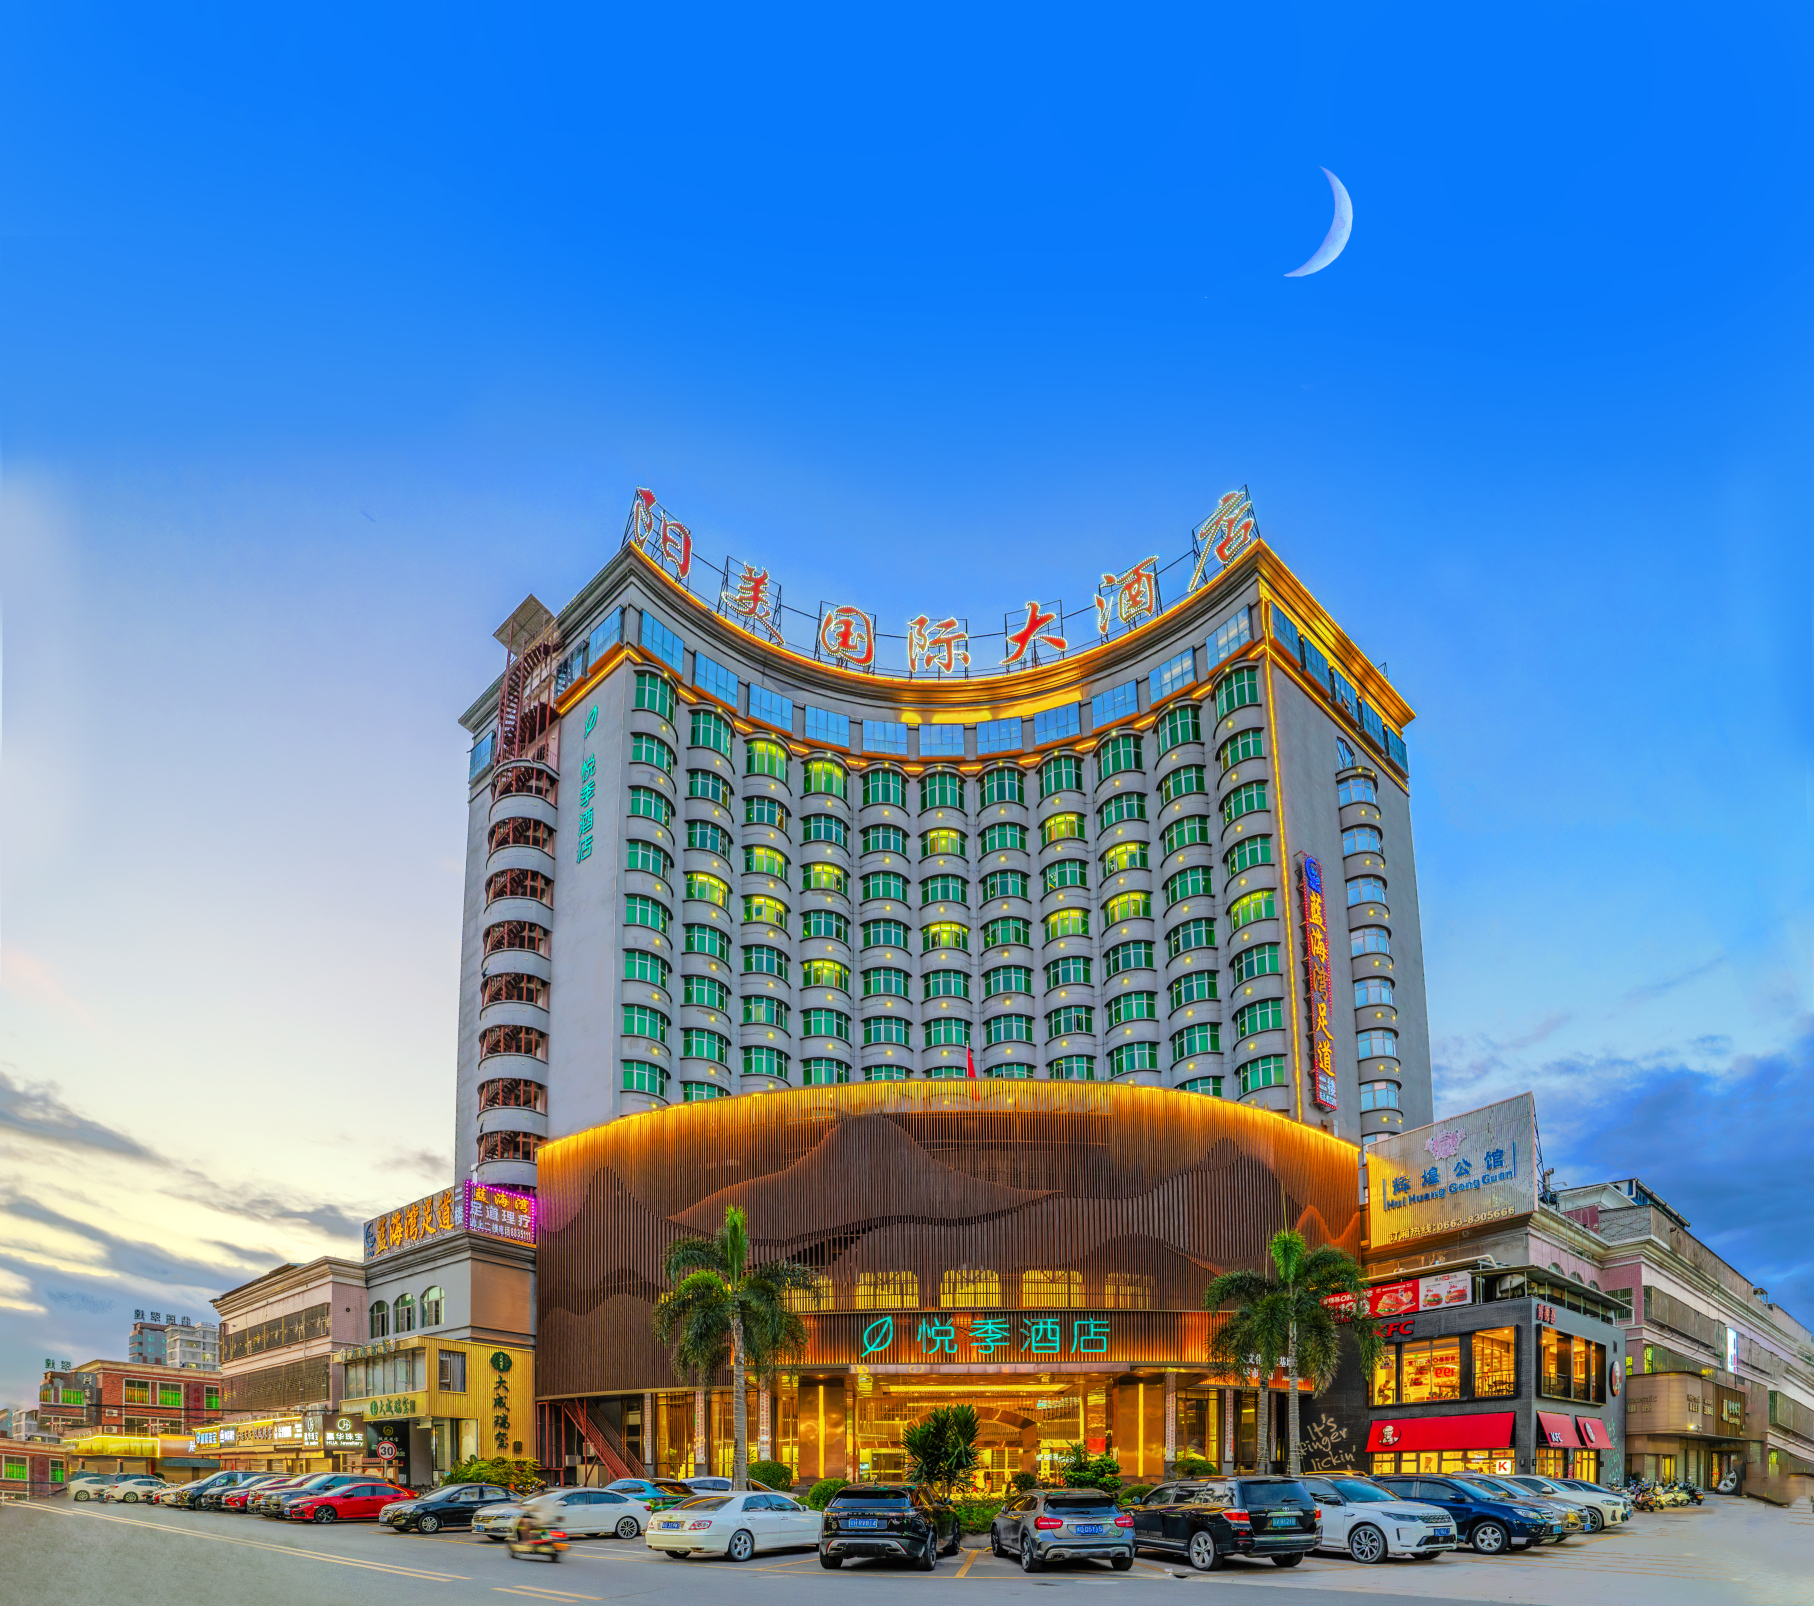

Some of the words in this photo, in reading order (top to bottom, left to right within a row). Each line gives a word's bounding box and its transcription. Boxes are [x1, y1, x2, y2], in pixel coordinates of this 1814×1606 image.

[633, 486, 1254, 673] 阳美国际大酒店
[576, 752, 596, 864] 悦季酒店
[1392, 1148, 1505, 1195] 辉煌公馆
[1387, 1197, 1407, 1210] Hui
[1408, 1187, 1445, 1205] Huang
[1449, 1178, 1480, 1194] Gong
[1482, 1169, 1513, 1185] Guan
[470, 1200, 532, 1229] 足道理疗
[917, 1317, 1110, 1354] 悦季酒店
[1373, 1320, 1415, 1338] KFC
[1306, 1413, 1338, 1441] It's
[380, 1446, 394, 1456] 30
[1299, 1428, 1348, 1456] finger
[1310, 1445, 1356, 1472] lickin'
[1498, 1461, 1508, 1472] K
